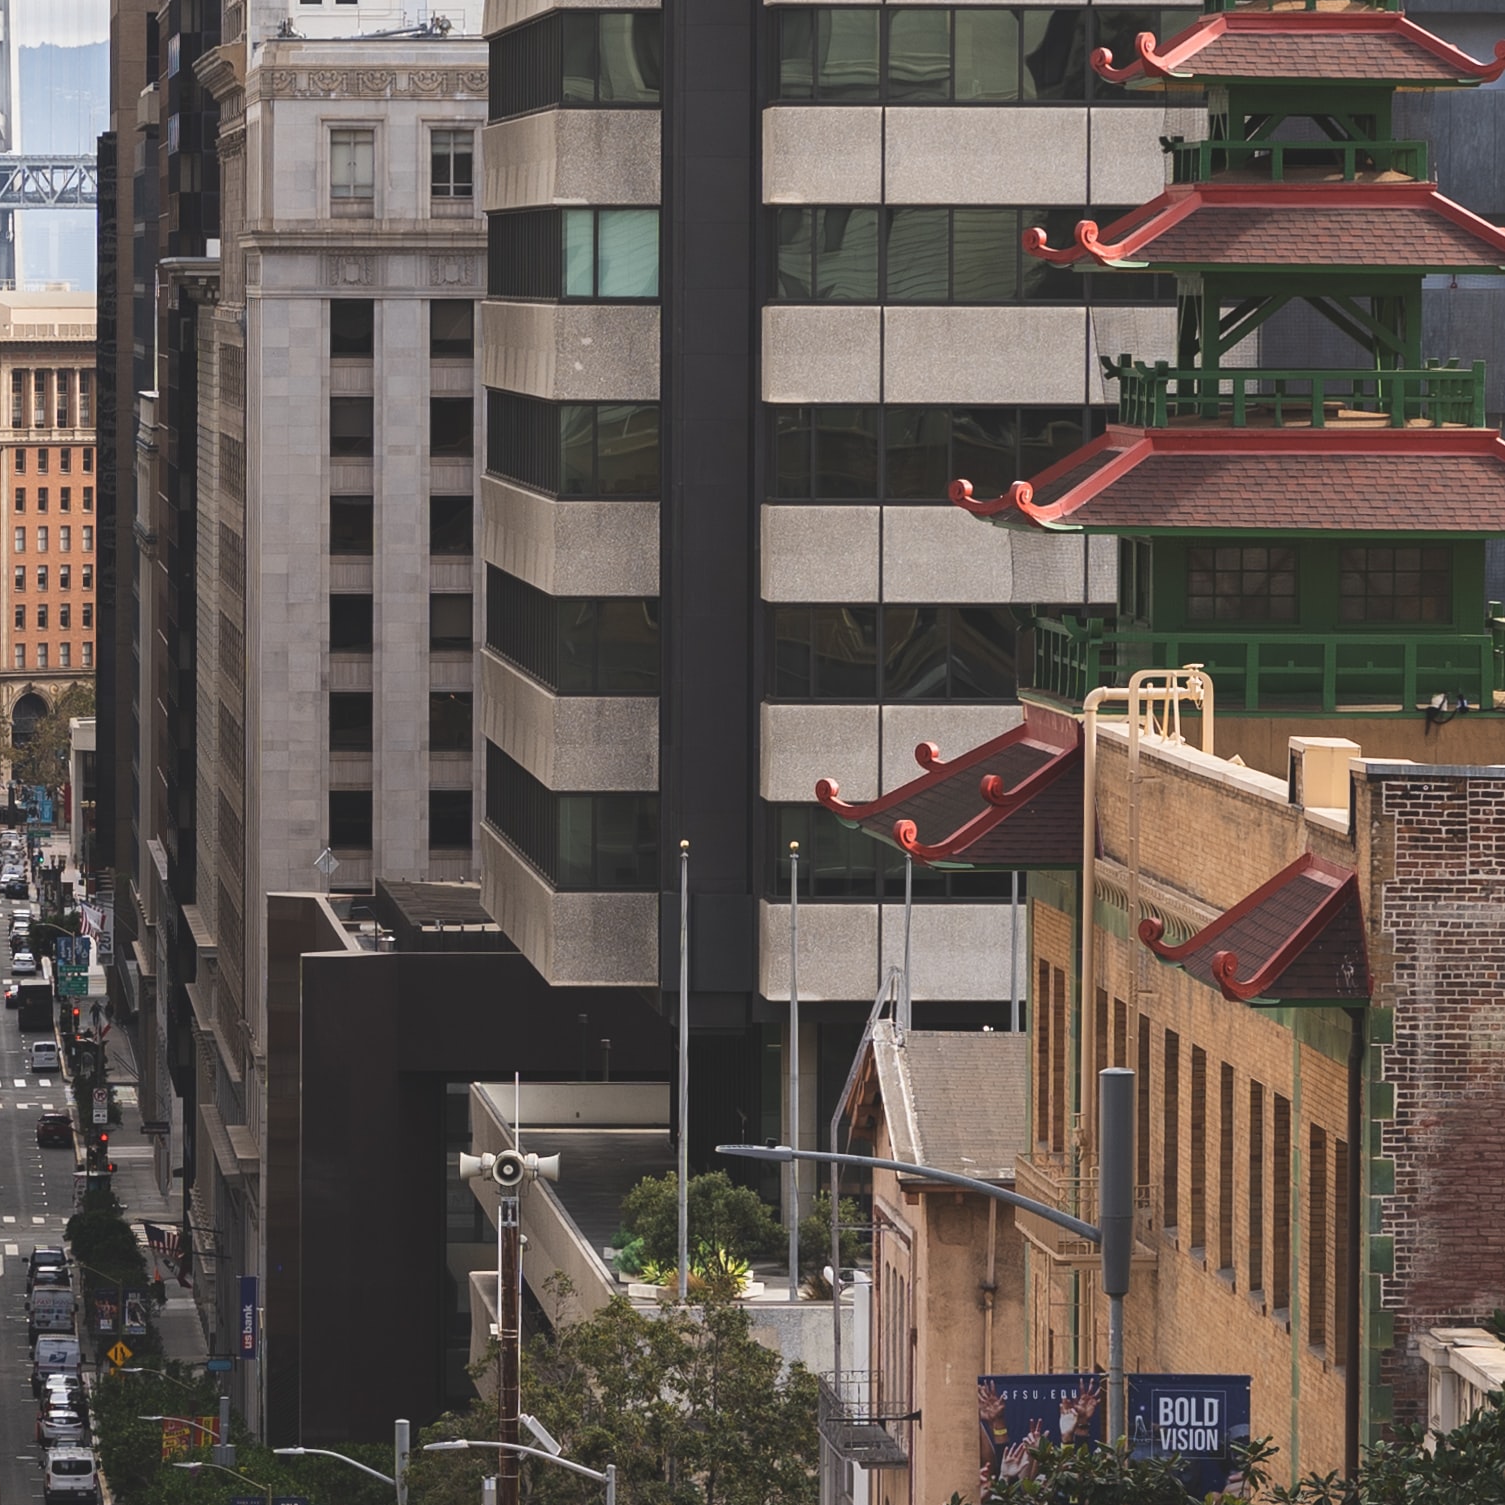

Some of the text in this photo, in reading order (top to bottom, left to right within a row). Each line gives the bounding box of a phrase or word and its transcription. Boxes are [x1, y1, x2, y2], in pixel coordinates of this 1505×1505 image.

[242, 1304, 252, 1334] bank
[1002, 1390, 1078, 1400] SFSU.EDU
[1159, 1397, 1219, 1426] BOLD
[1159, 1428, 1218, 1451] VISION
